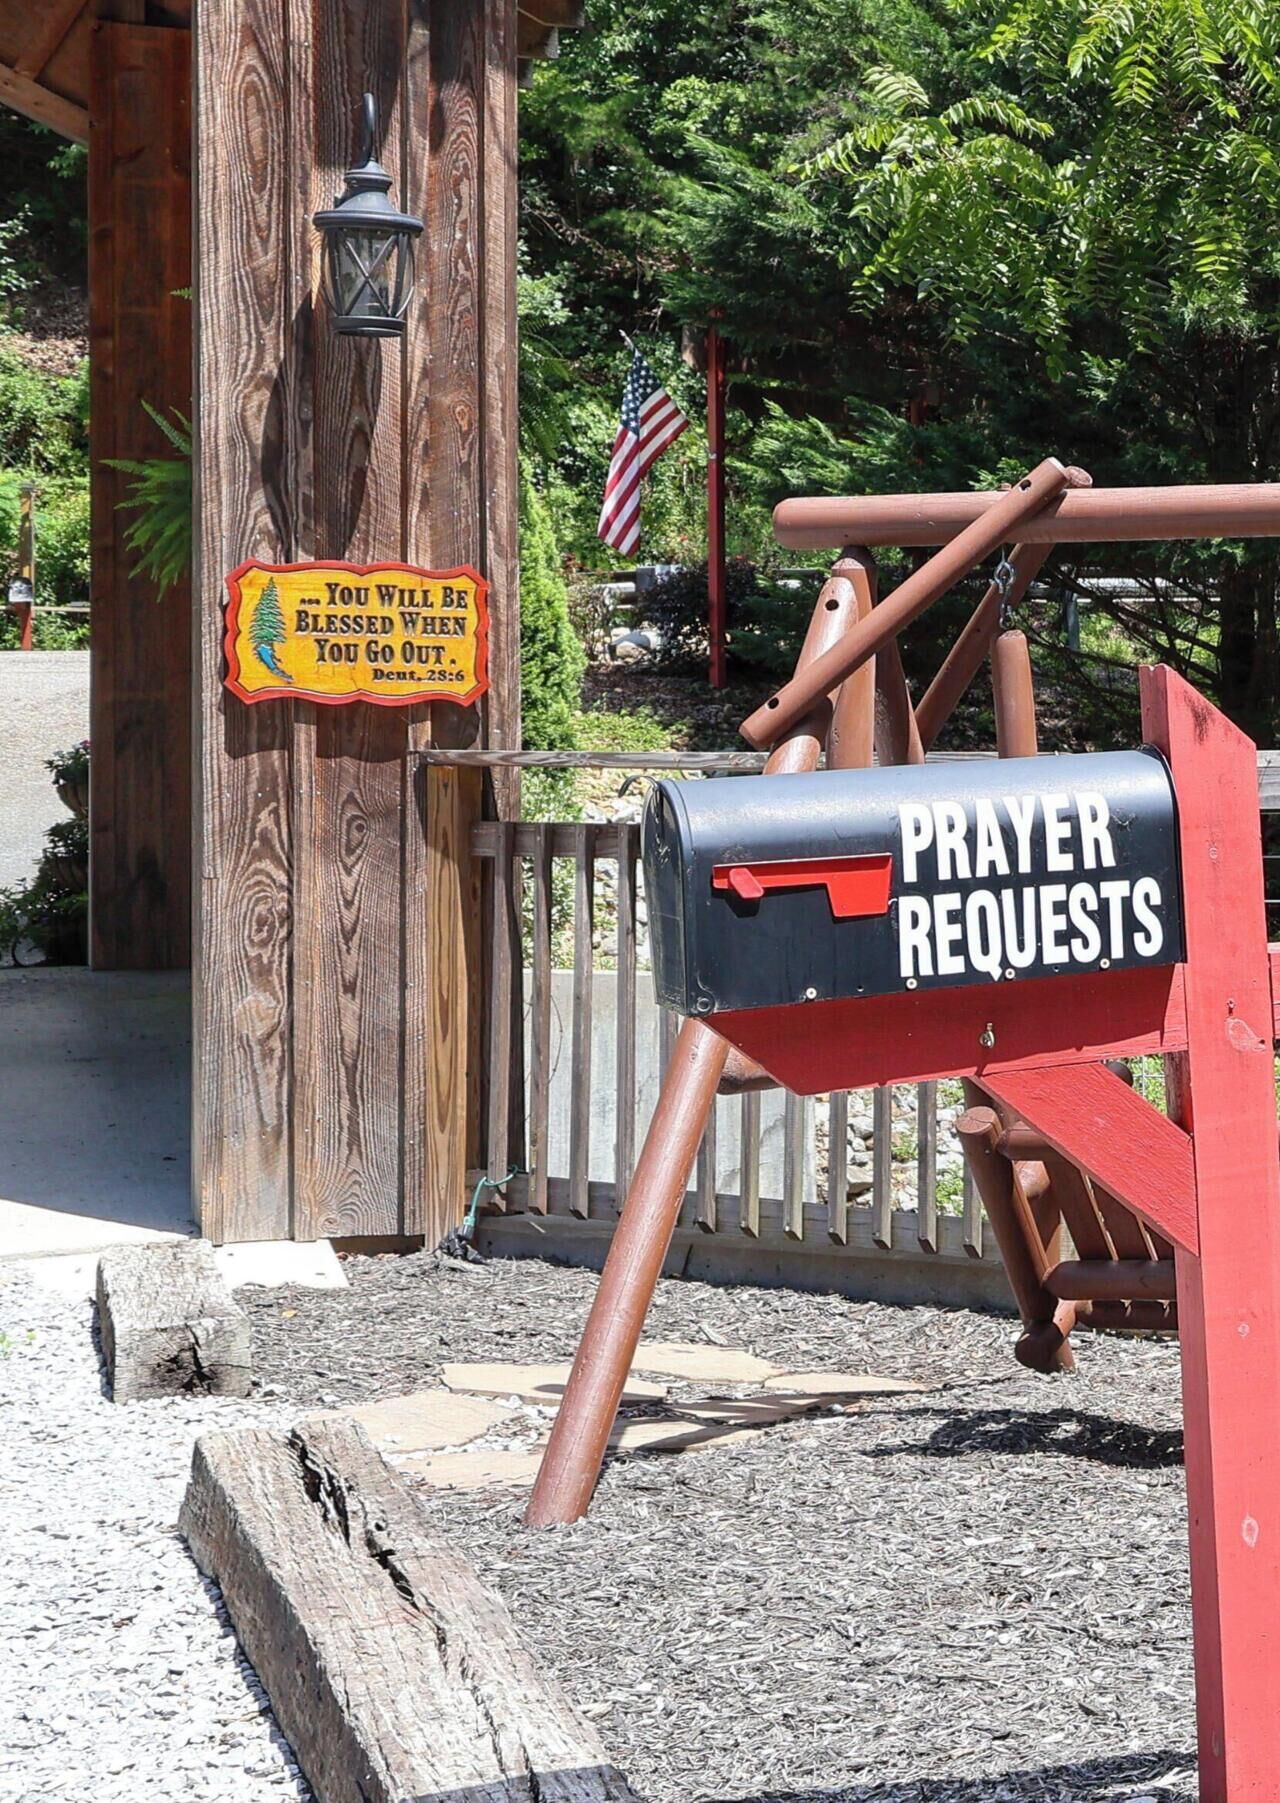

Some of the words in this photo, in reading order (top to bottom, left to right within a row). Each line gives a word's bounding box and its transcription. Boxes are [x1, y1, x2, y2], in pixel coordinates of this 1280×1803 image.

[375, 584, 434, 609] WILL
[440, 586, 468, 610] BE
[295, 609, 395, 636] BLESSED
[400, 611, 467, 637] WHEN
[315, 638, 359, 664] YOU
[366, 640, 394, 664] GO
[427, 669, 465, 683] 28:6
[900, 793, 1116, 882] PRAYER
[900, 876, 1164, 981] REQUESTS
